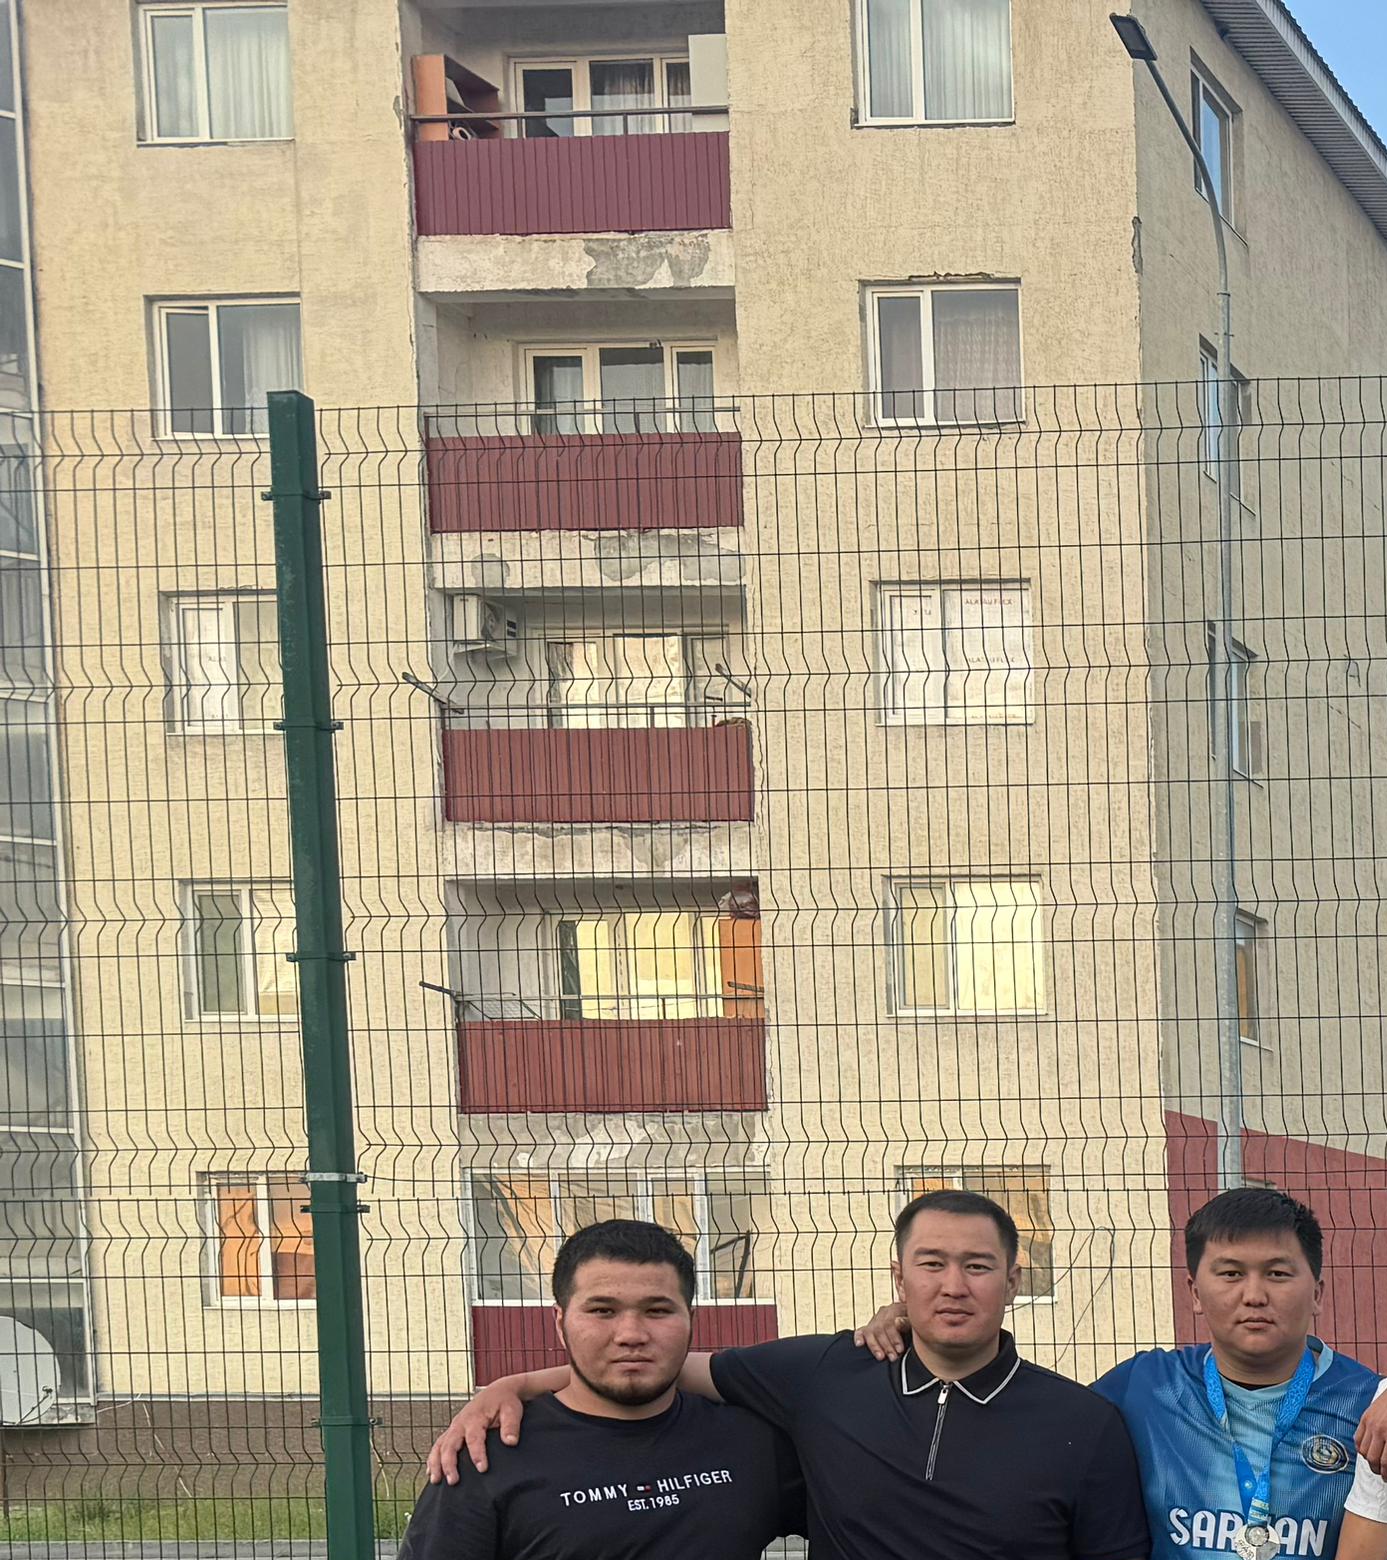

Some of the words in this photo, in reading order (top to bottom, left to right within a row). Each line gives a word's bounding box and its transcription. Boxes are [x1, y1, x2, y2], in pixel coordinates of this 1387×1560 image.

[560, 1483, 629, 1507] TOMMY
[656, 1469, 733, 1493] HILFIGER
[1168, 1507, 1328, 1557] SARAN
